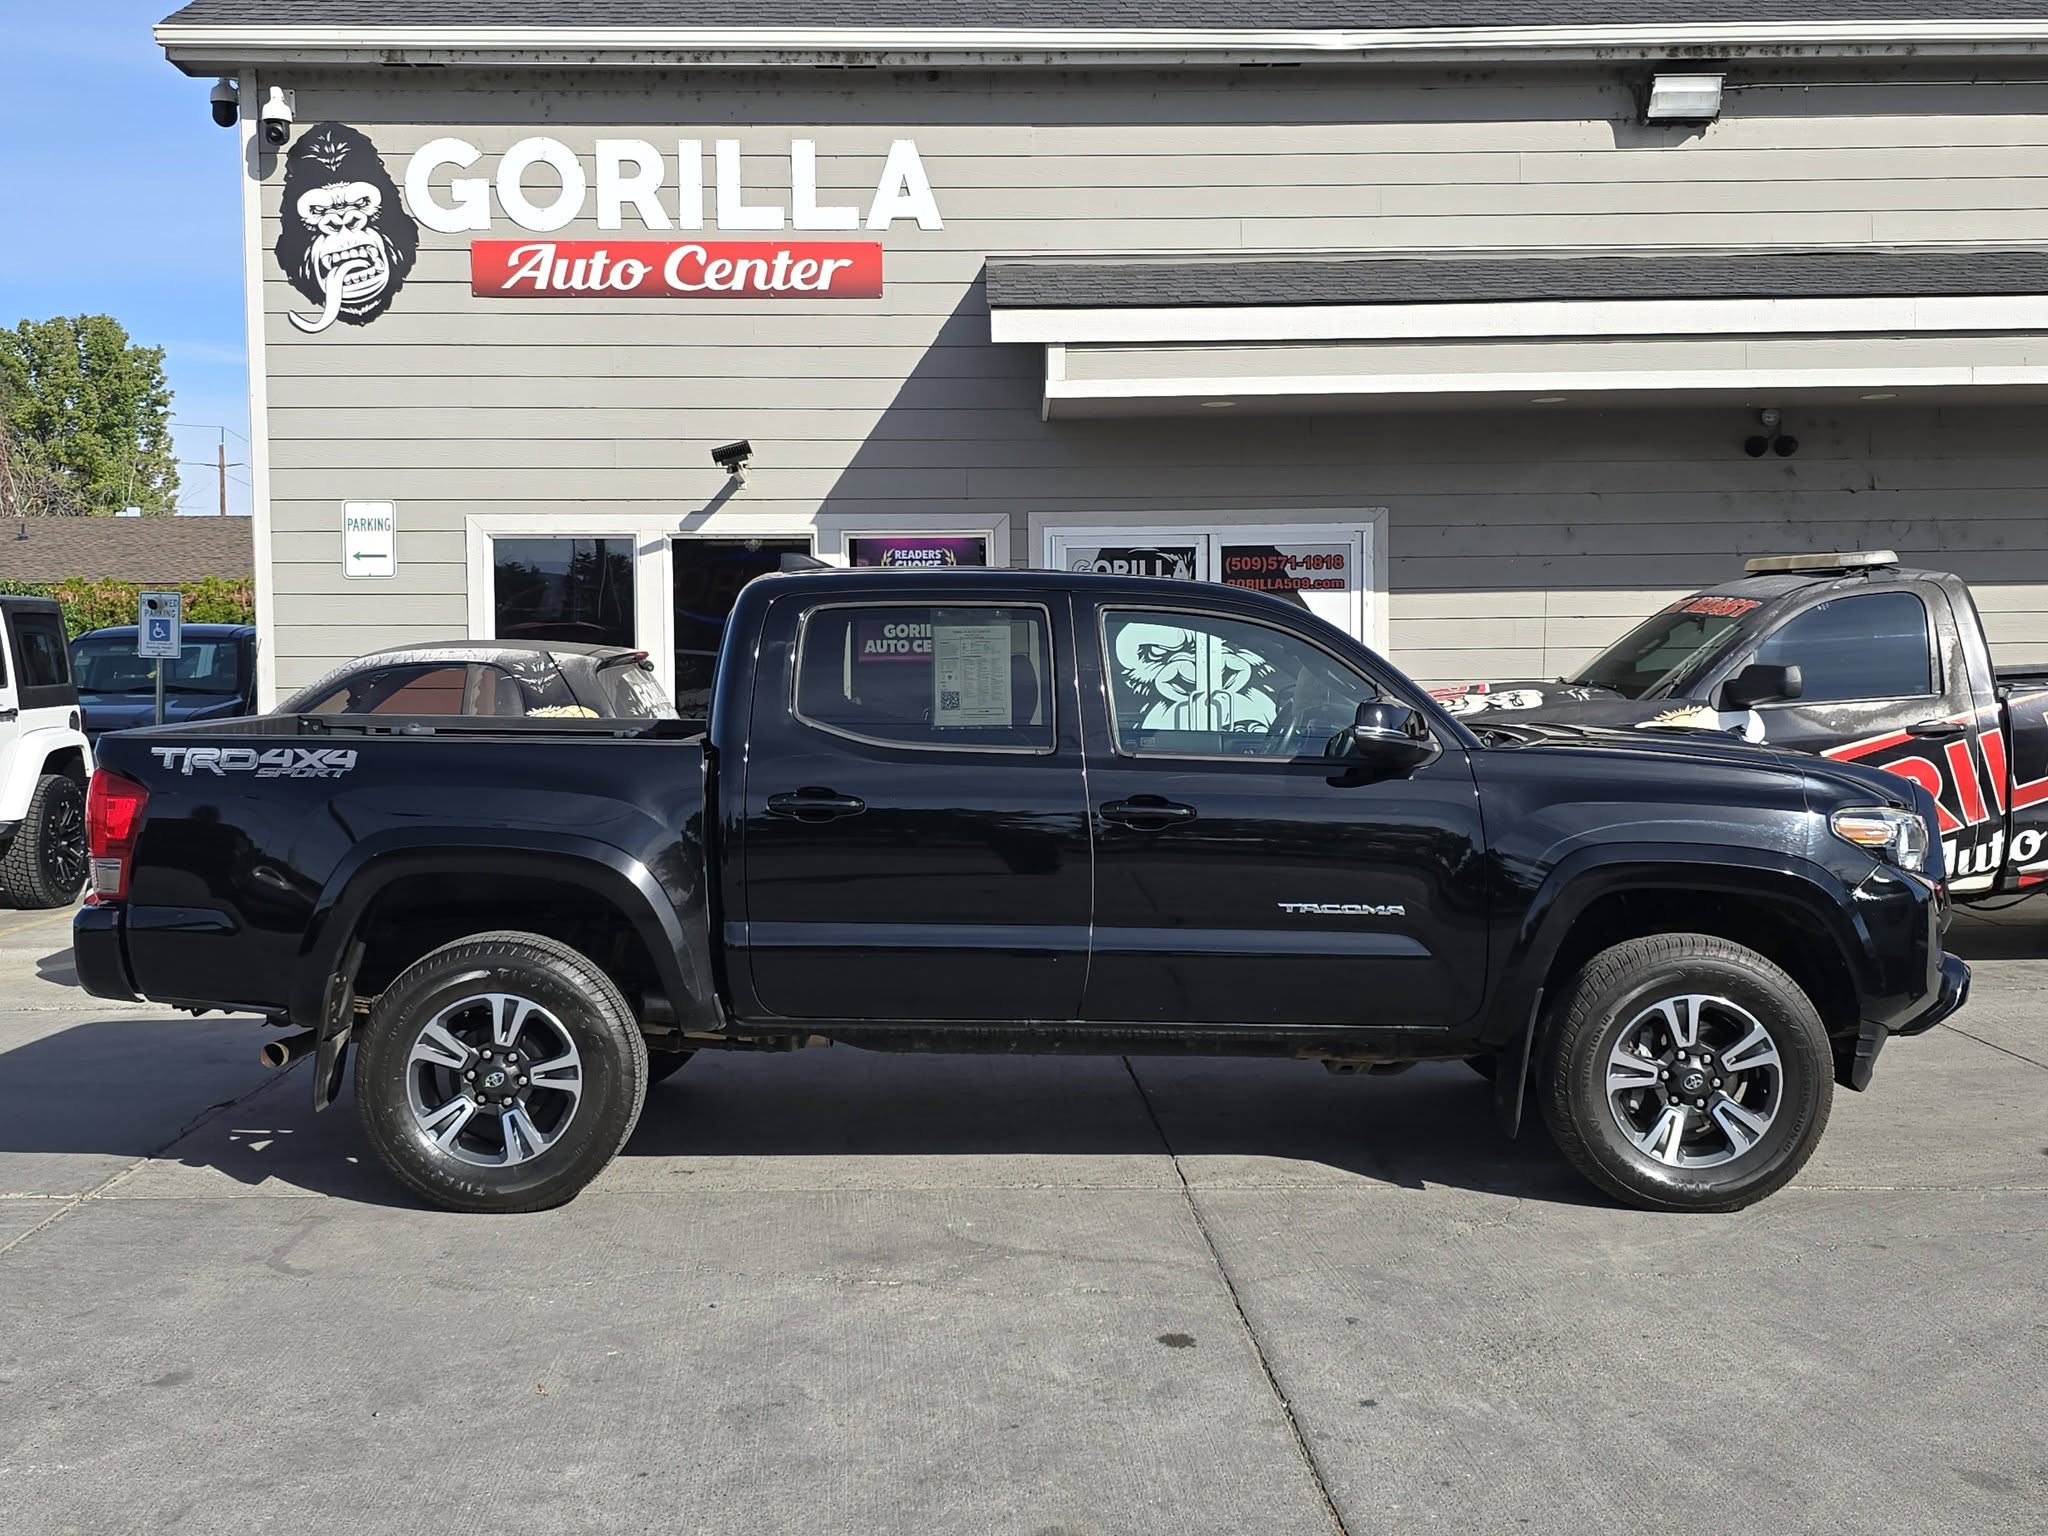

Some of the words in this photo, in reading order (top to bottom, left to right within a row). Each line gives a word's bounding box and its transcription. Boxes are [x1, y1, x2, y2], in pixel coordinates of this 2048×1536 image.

[404, 137, 944, 233] GORILLA
[501, 243, 654, 291] Auto
[663, 243, 853, 291] Center
[347, 517, 391, 532] PARKING
[1225, 554, 1345, 574] (509)571-1818
[144, 609, 176, 618] PARKING
[864, 639, 910, 653] AUTO
[255, 767, 355, 778] SPORT
[1278, 903, 1405, 915] TACOMA
